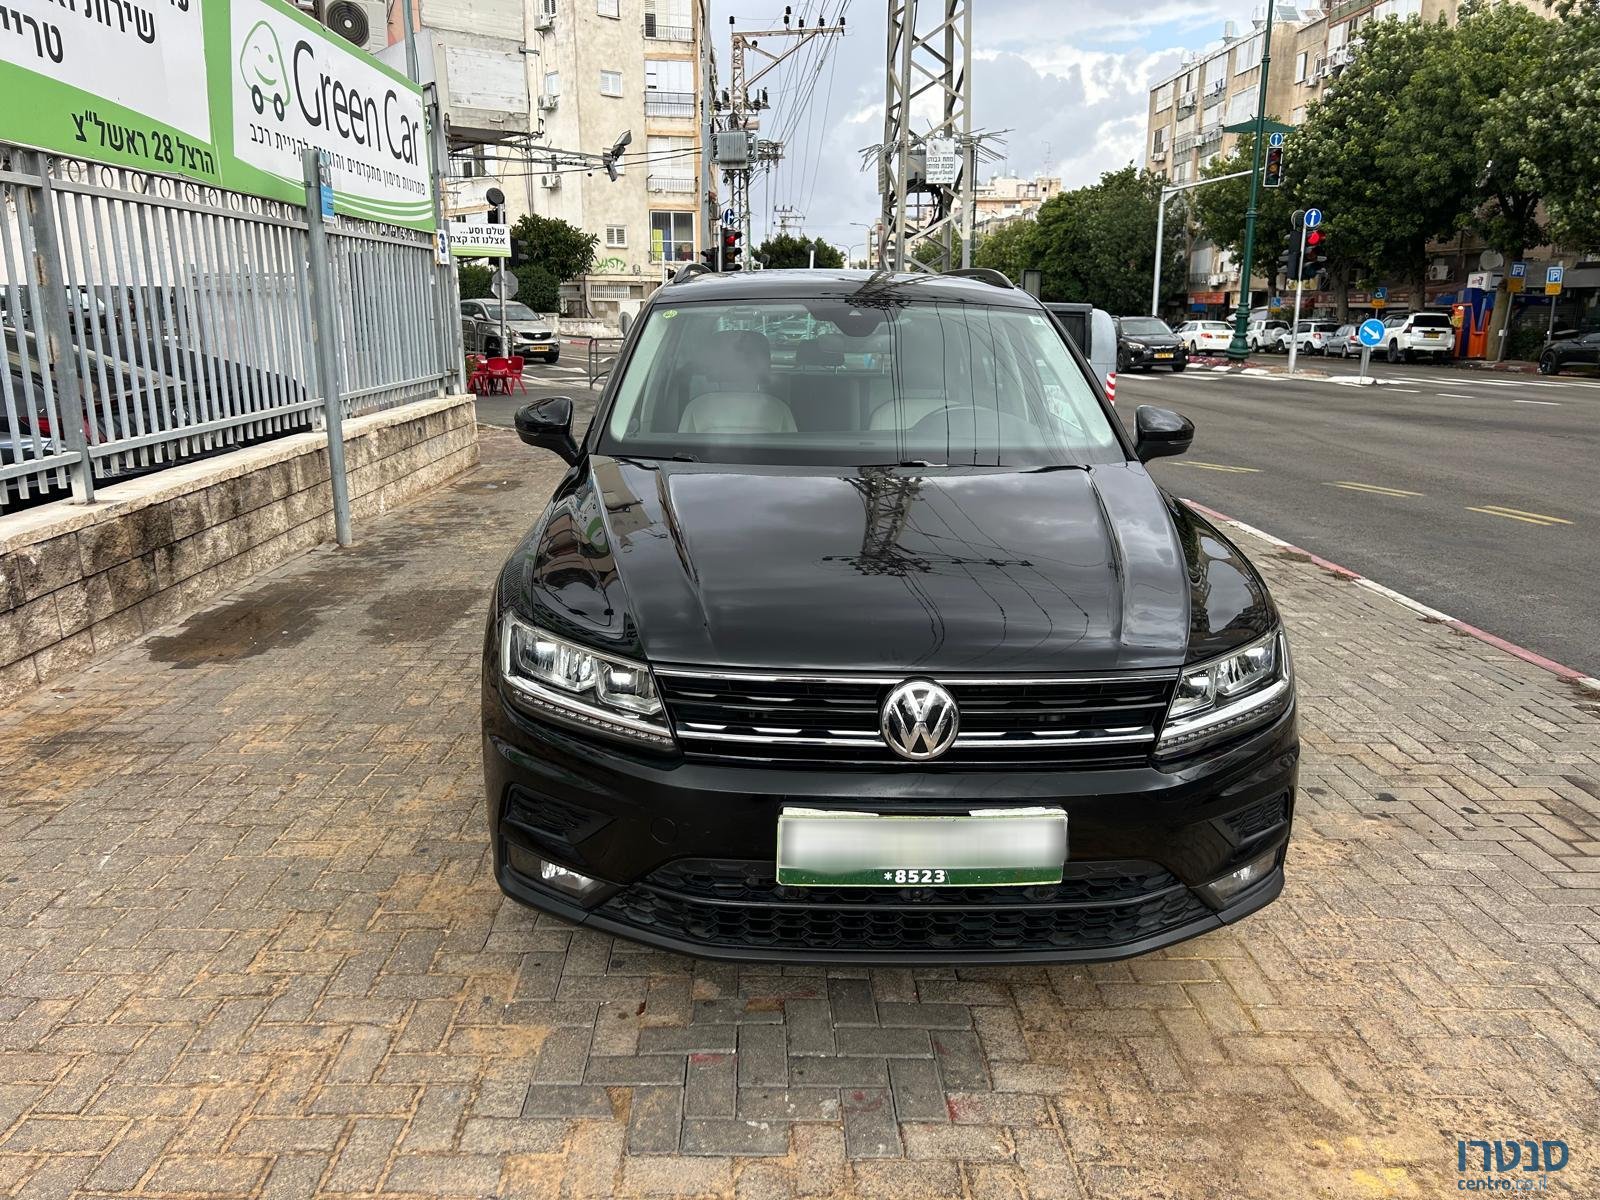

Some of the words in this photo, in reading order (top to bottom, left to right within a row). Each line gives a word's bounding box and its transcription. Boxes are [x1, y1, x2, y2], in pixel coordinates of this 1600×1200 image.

[293, 40, 381, 151] Green
[384, 89, 419, 166] Car
[250, 123, 272, 147] רכב
[151, 131, 174, 164] 28
[175, 135, 215, 174] הרצל
[347, 158, 381, 183] מתקדמים
[383, 170, 401, 188] מימון
[402, 177, 426, 195] פתרונות
[450, 235, 468, 245] קצת
[470, 236, 480, 244] זה
[482, 235, 506, 245] אצלנו
[486, 226, 505, 236] שלם
